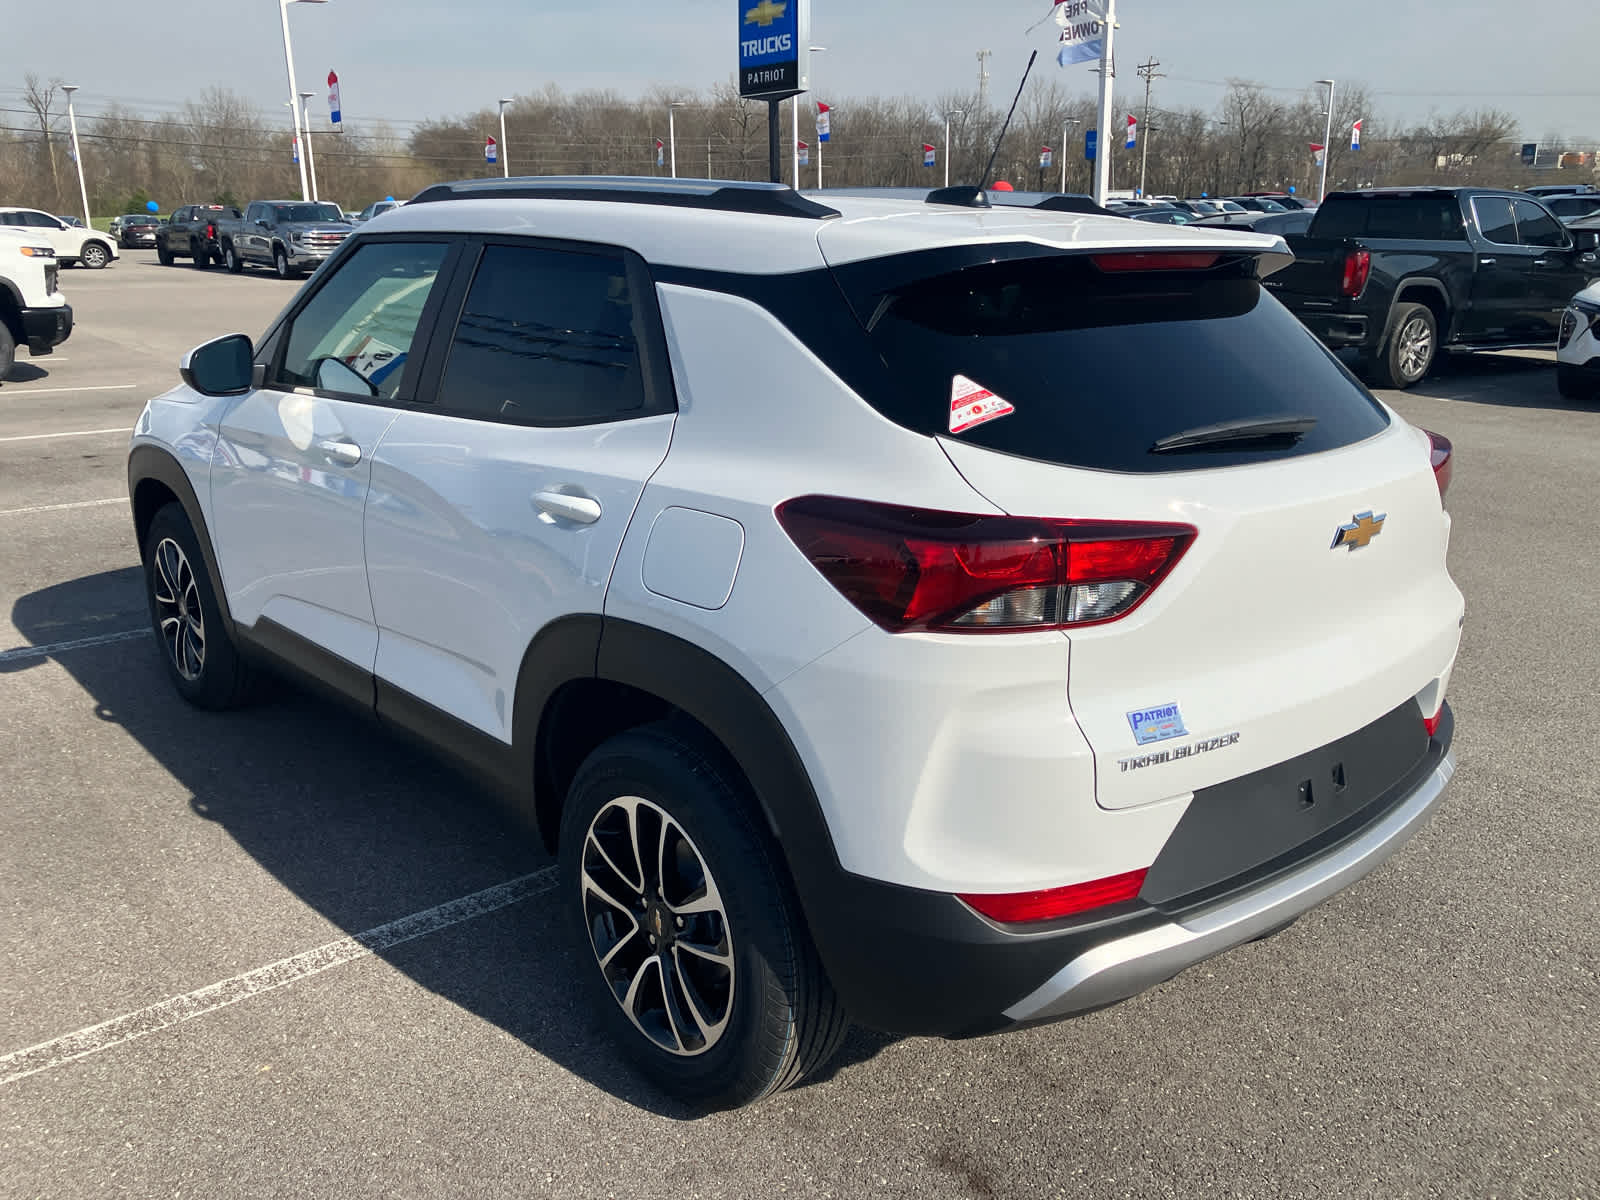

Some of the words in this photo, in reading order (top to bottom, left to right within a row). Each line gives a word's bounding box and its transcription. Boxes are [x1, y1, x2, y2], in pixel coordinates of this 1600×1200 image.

[741, 33, 791, 57] TRUCKS
[747, 68, 785, 85] PATRIOT
[1132, 705, 1178, 730] PATRIOT
[1117, 731, 1240, 772] TRAILBLAZER
